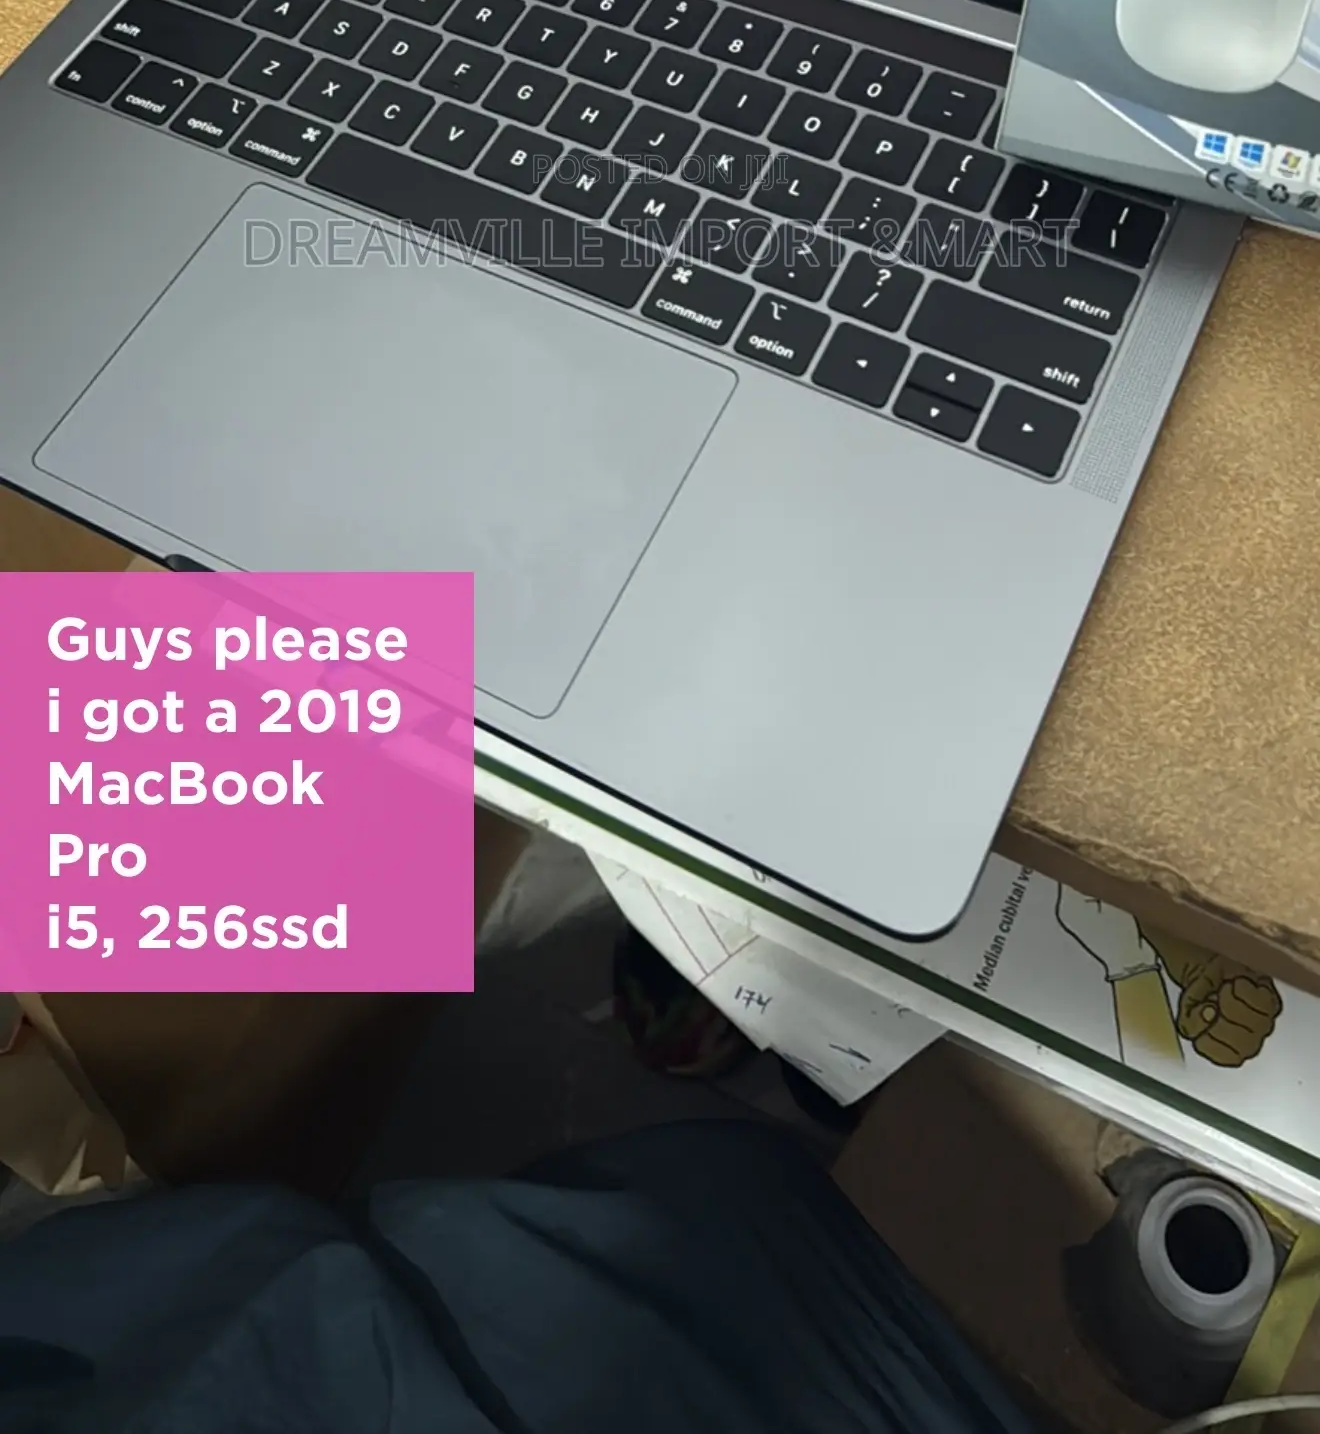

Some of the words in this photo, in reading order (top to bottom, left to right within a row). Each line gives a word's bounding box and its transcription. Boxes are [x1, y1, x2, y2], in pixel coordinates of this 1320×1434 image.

[275, 2, 290, 16] A
[114, 21, 141, 37] shift
[334, 21, 350, 35] S
[392, 42, 409, 56] D
[68, 70, 82, 82] fn
[125, 93, 165, 113] control
[187, 117, 223, 137] option
[244, 139, 300, 166] command
[876, 141, 893, 154] P
[716, 155, 735, 171] K
[655, 298, 723, 330] command
[1063, 294, 1111, 321] return
[749, 334, 794, 359] option
[1043, 365, 1081, 389] shift
[973, 934, 1006, 992] Median
[999, 881, 1027, 934] cubital
